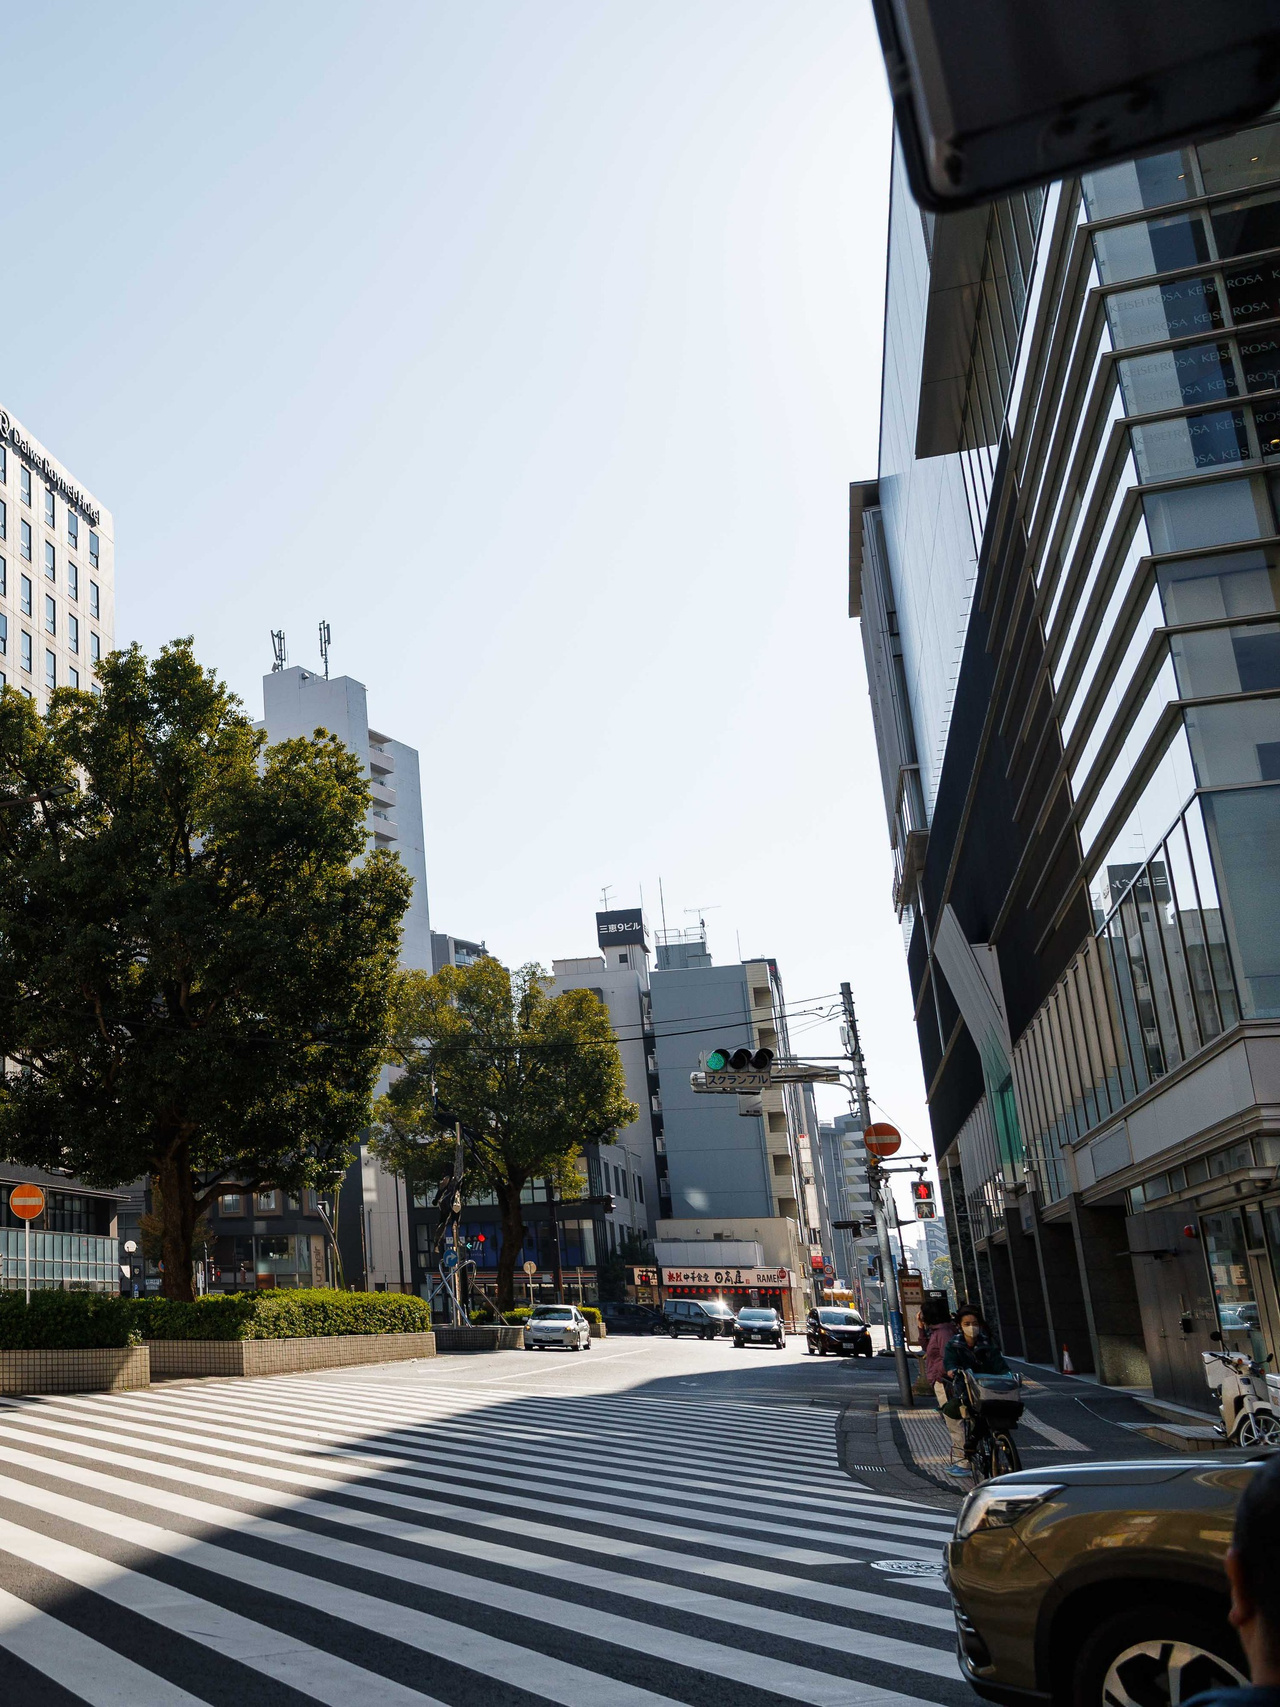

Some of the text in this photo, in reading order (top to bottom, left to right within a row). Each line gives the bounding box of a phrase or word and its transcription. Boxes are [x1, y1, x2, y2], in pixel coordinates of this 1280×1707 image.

[1146, 291, 1182, 306] ROSA
[1226, 273, 1263, 289] ROSA
[1232, 301, 1270, 316] ROSA
[1241, 341, 1279, 356] ROSA
[13, 427, 43, 469] Daiwa
[43, 457, 80, 503] Roynet
[79, 490, 100, 526] Hotel
[599, 922, 641, 934] 三恵9ビル
[708, 1074, 769, 1085] スクランブル
